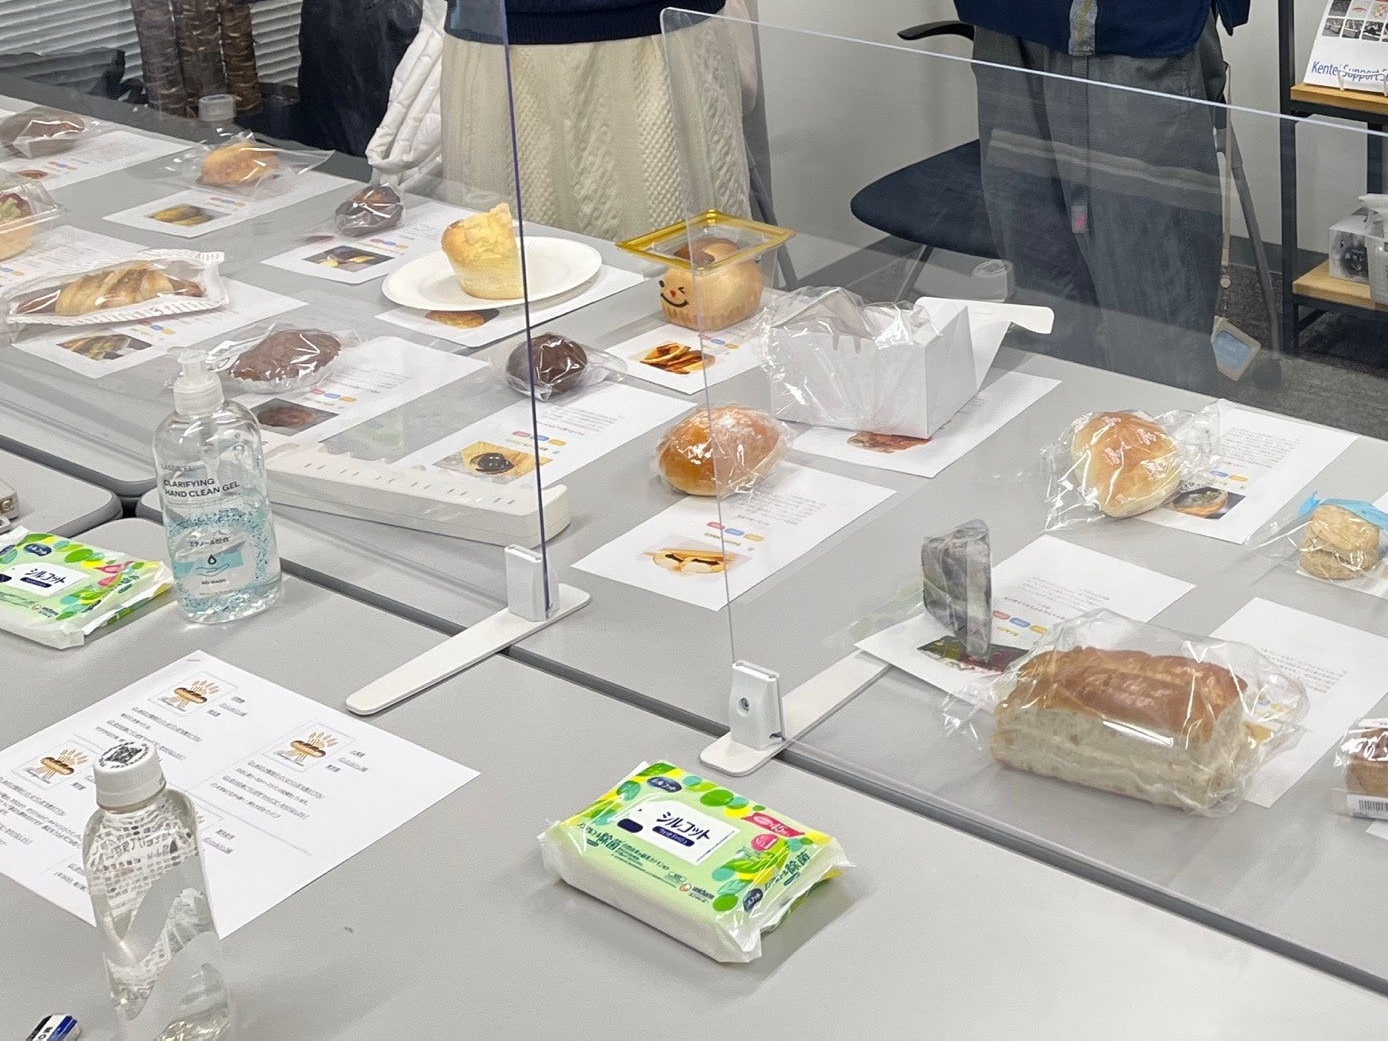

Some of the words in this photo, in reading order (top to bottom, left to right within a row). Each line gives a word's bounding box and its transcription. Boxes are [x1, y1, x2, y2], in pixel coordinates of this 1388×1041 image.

[163, 478, 215, 488] CLARIFYING
[165, 489, 188, 498] HAND
[188, 487, 220, 498] CLEAN
[222, 481, 240, 492] GEL
[24, 567, 67, 585] シルコット
[656, 811, 710, 840] シルコット
